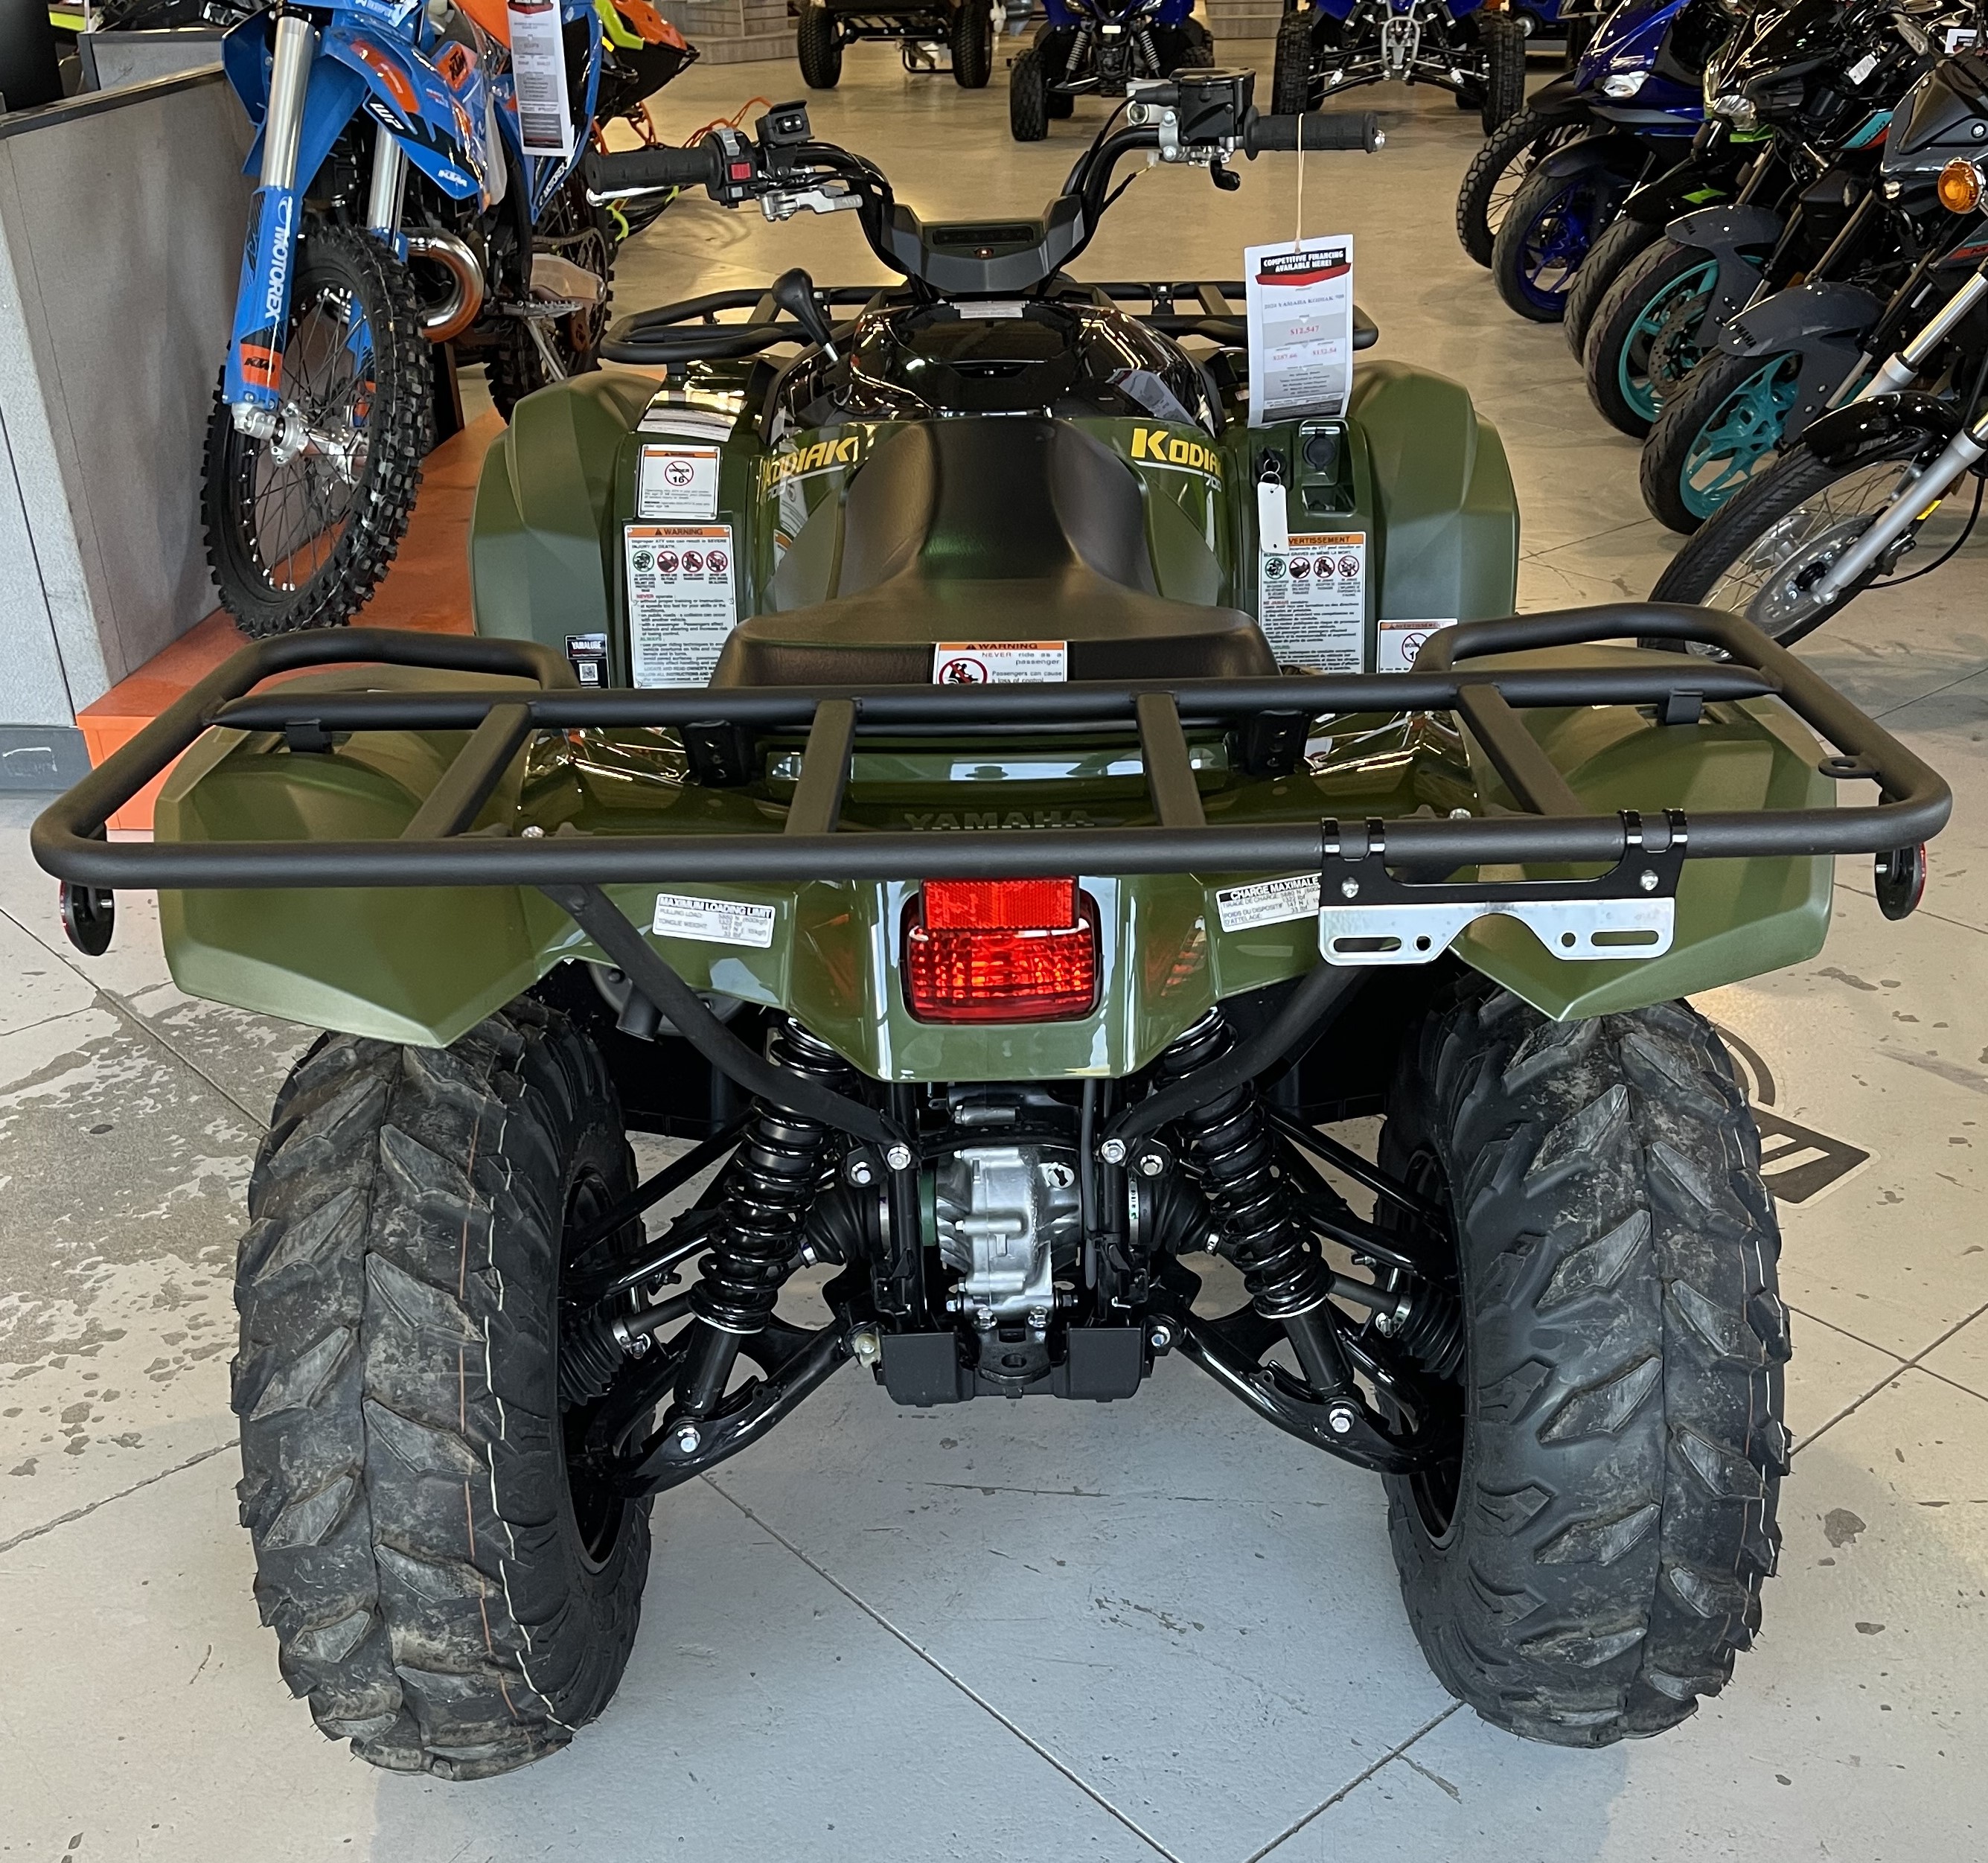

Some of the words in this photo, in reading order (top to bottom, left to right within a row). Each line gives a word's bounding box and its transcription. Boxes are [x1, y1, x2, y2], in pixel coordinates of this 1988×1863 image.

[438, 169, 467, 188] KTM
[1263, 255, 1306, 266] COMPETITIVE
[1308, 250, 1343, 261] FINANCING
[1275, 262, 1310, 272] AVAILABLE
[1312, 259, 1332, 267] HERE!
[265, 226, 290, 320] MOTOREX
[1288, 536, 1350, 544] VERTISSEMENT
[904, 810, 1095, 831] YAMAHA
[1230, 886, 1269, 900] CHARGE
[1271, 877, 1319, 893] MAXIMALE
[706, 903, 746, 915] LOADING
[747, 907, 771, 918] LIMIT
